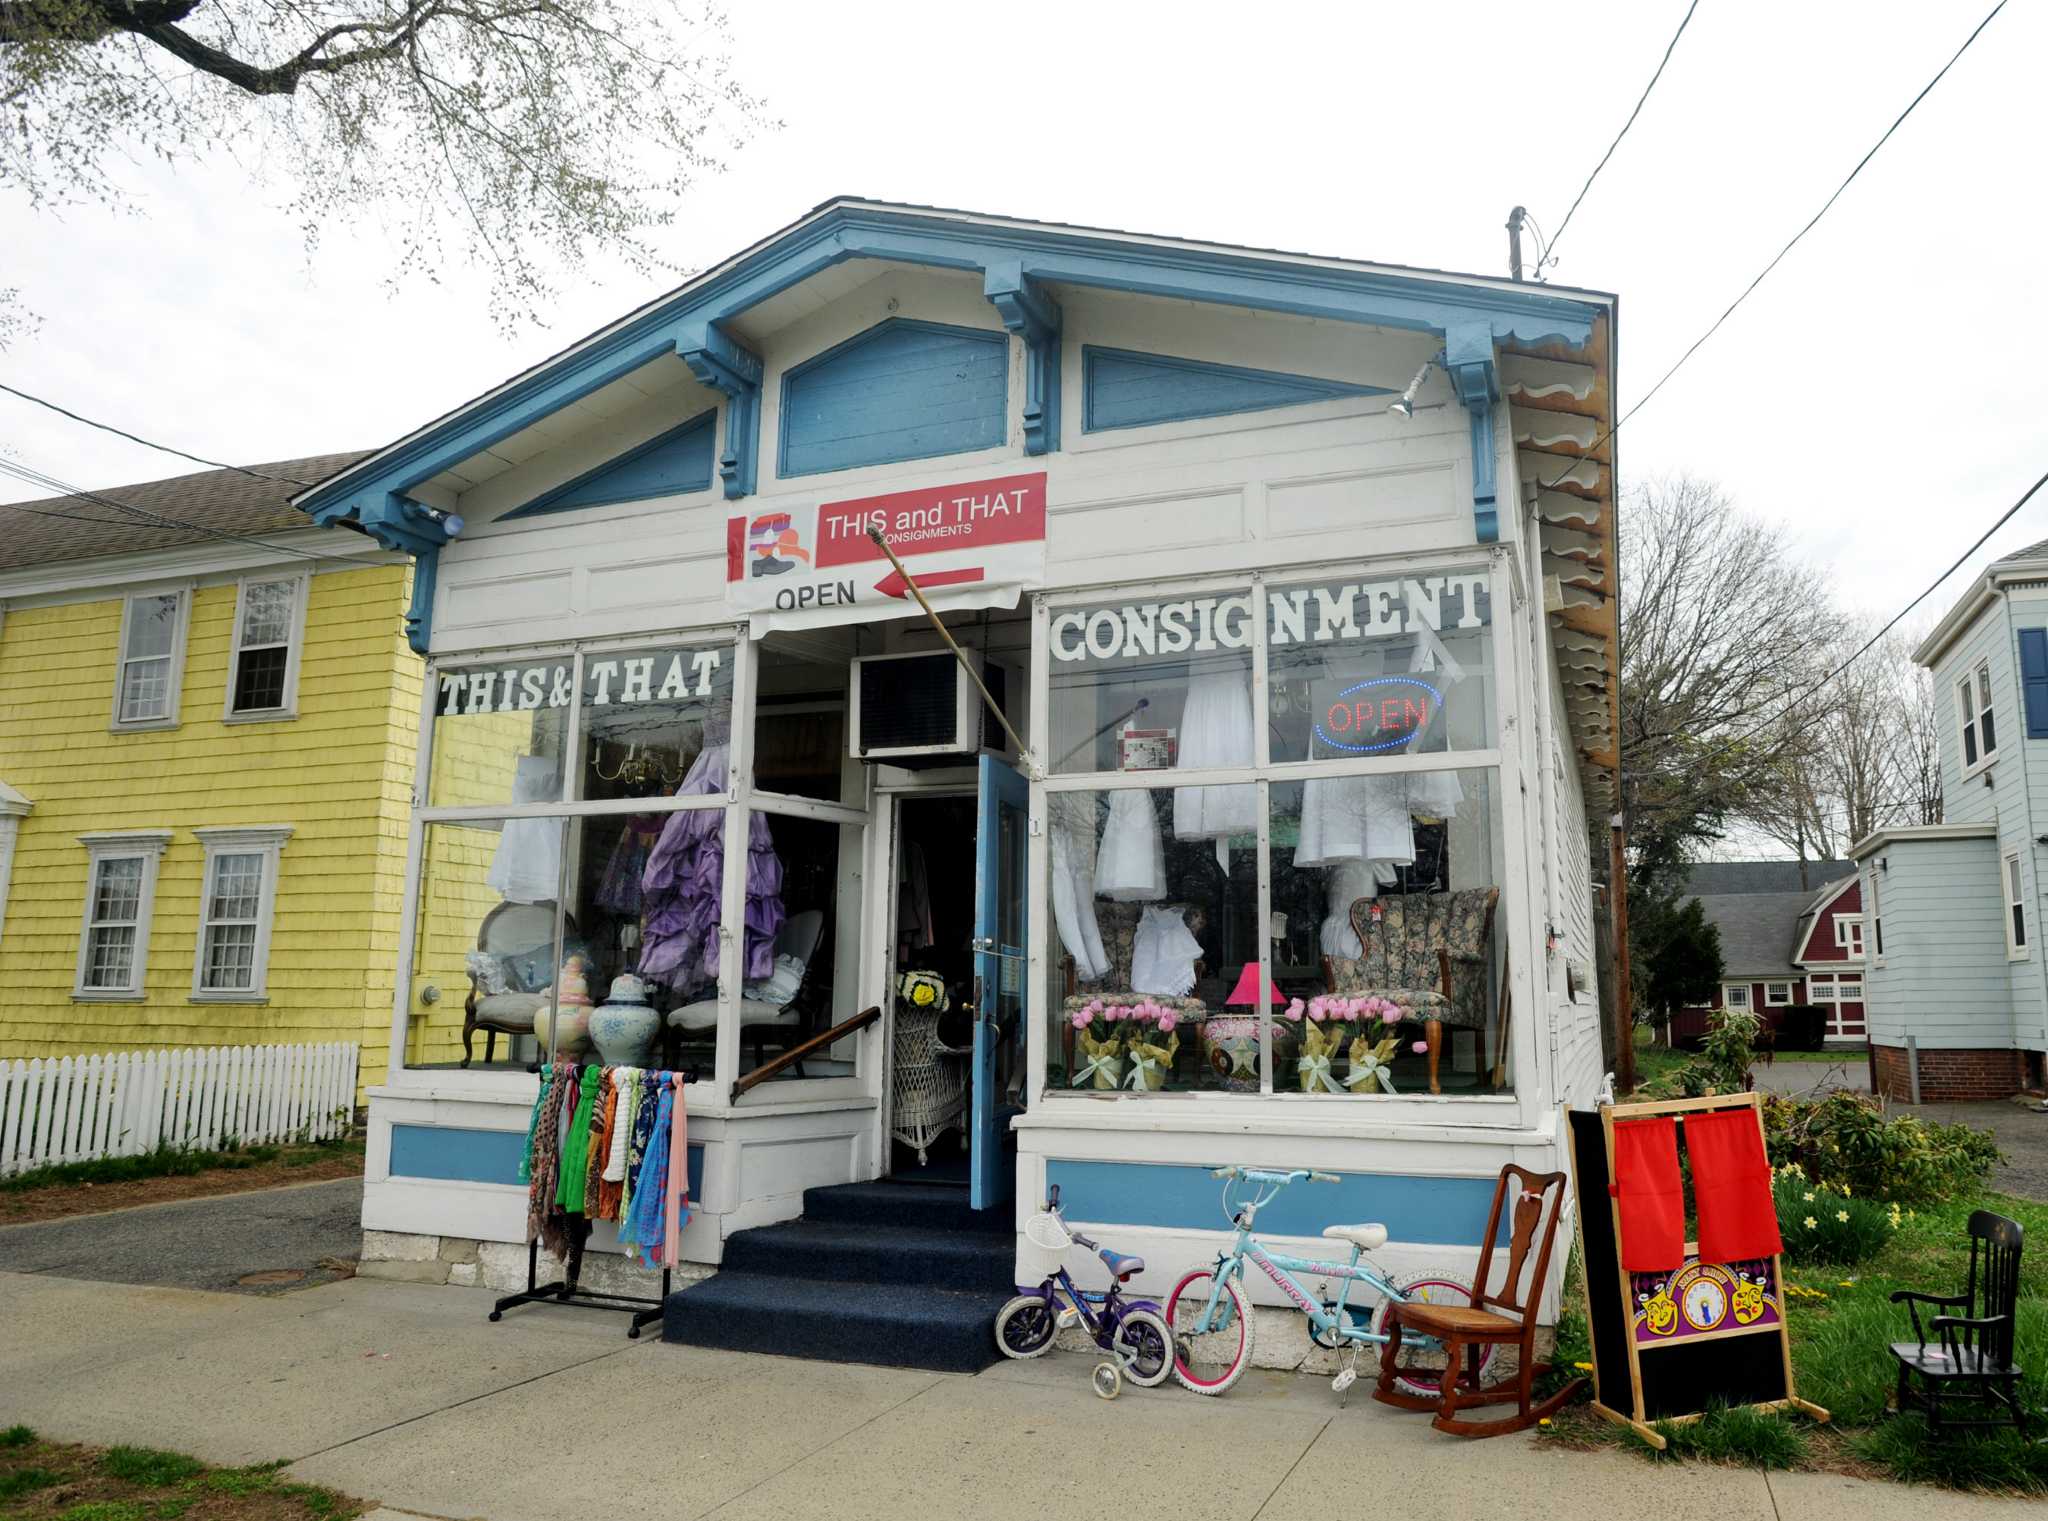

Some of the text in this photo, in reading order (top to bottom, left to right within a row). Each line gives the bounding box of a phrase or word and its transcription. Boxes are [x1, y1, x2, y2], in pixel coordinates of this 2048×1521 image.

[826, 489, 1029, 540] THIS and THAT
[876, 523, 973, 545] ONSIGNMENTS
[775, 580, 856, 611] OPEN
[1049, 574, 1489, 662] CONSIGNMENT
[590, 650, 721, 706] THAT
[1327, 697, 1429, 734] OPEN
